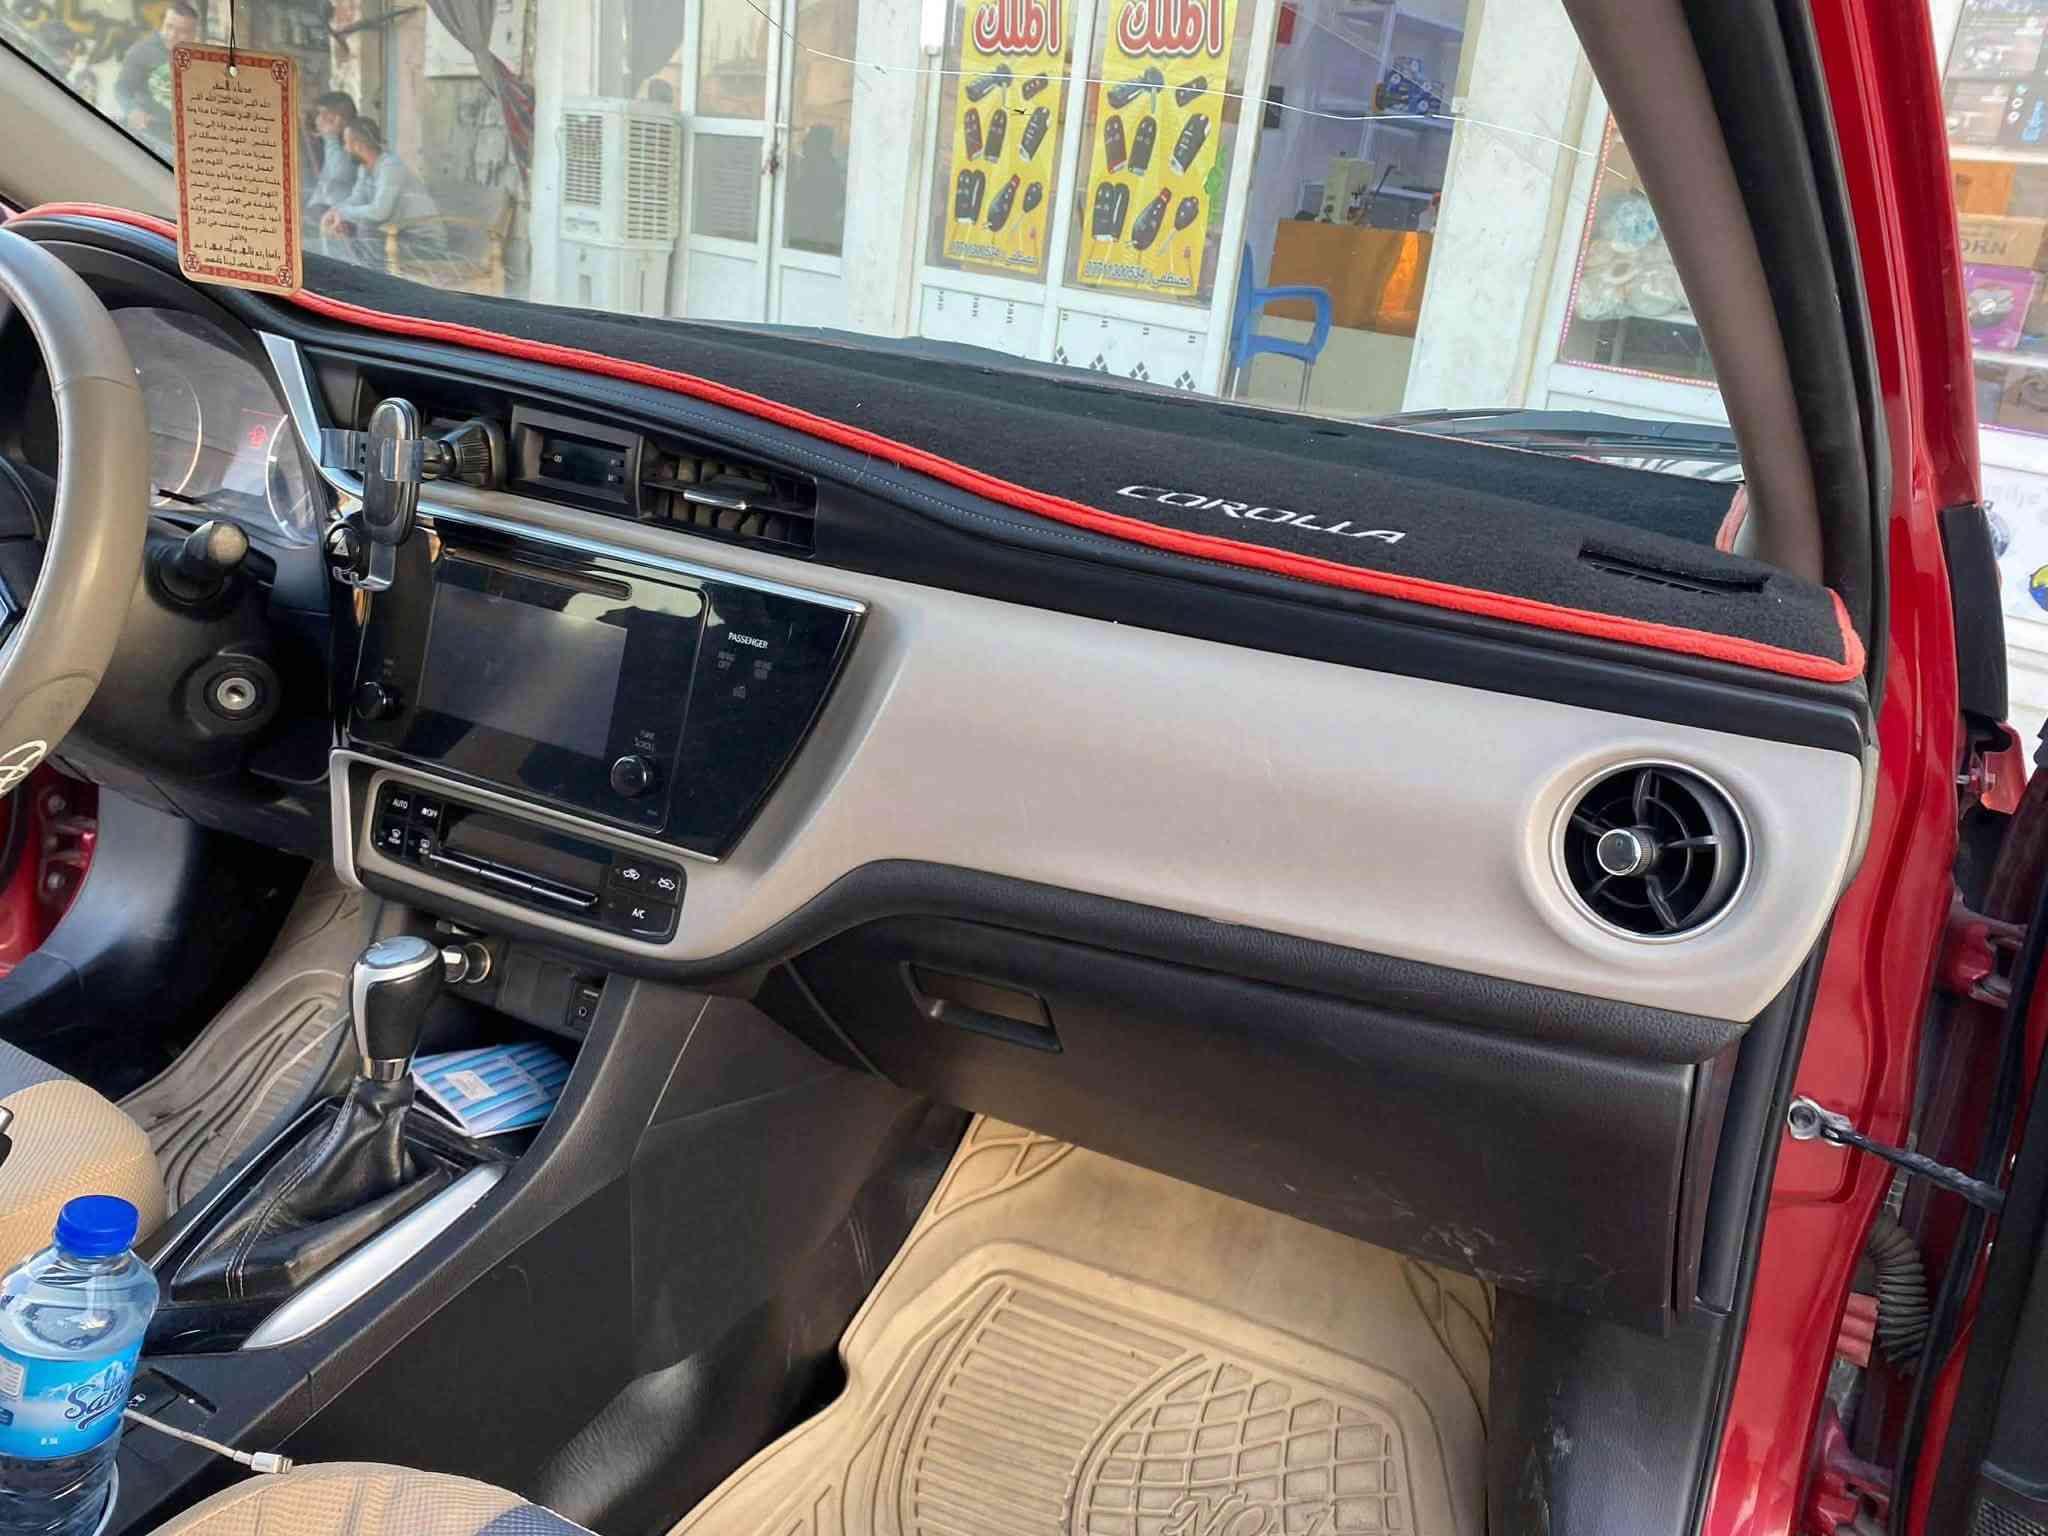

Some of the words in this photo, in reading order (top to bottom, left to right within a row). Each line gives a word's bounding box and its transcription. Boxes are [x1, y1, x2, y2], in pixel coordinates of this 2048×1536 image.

[1116, 485, 1407, 545] COROLLA
[728, 632, 769, 648] PASSENGER
[392, 798, 408, 809] AUTO
[631, 908, 646, 919] A/C
